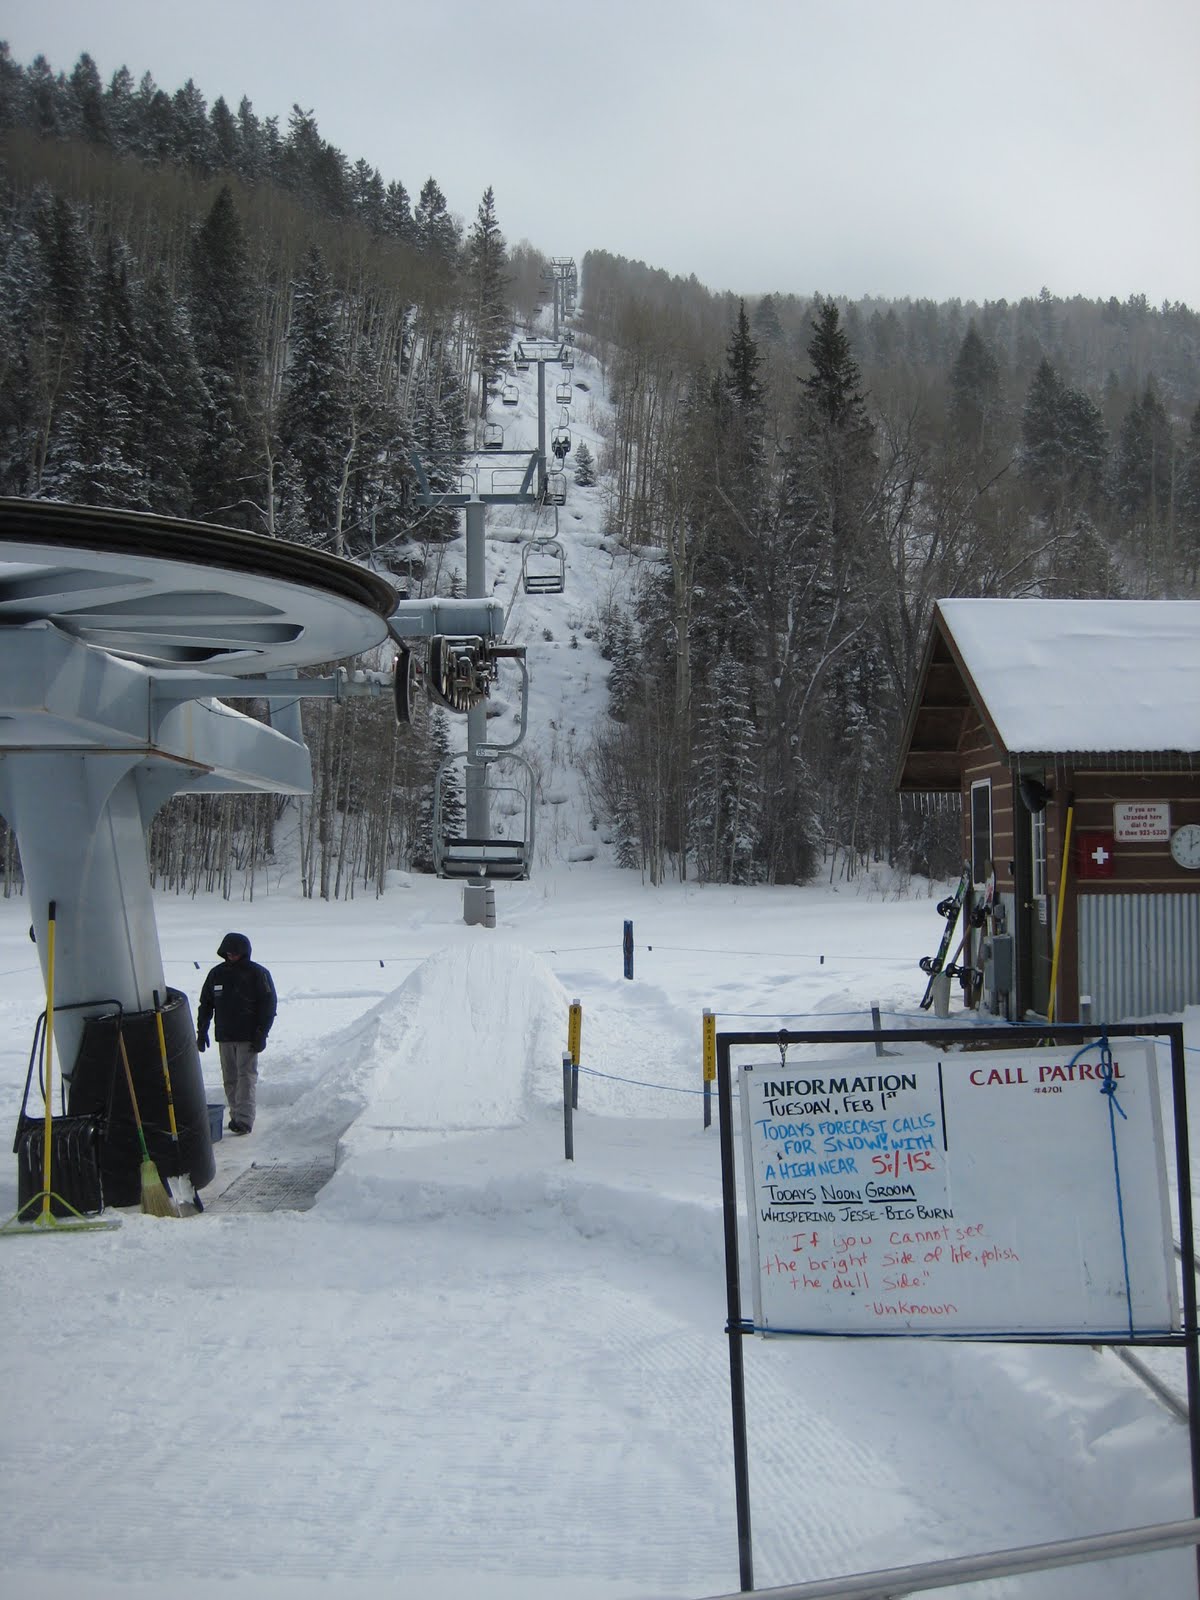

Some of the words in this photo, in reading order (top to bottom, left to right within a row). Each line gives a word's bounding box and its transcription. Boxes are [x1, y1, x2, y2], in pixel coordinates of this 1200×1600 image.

[969, 1068, 1028, 1086] CALL
[1038, 1062, 1125, 1083] PATROL
[764, 1074, 917, 1097] INFORMATION
[1033, 1086, 1063, 1094] #4701
[843, 1095, 874, 1113] FEB
[754, 1119, 815, 1140] TODAYS
[818, 1119, 887, 1136] FORECAST
[892, 1114, 936, 1133] CALLS
[784, 1139, 817, 1155] FOR
[891, 1134, 936, 1150] WITH
[765, 1164, 776, 1181] A
[780, 1161, 816, 1179] HIGH
[818, 1157, 859, 1177] NEAR
[761, 1184, 817, 1201] TODAYS
[820, 1184, 861, 1200] NOON
[865, 1181, 916, 1197] GROOM
[761, 1209, 836, 1223] WHISPERING
[916, 1205, 954, 1220] BURN
[833, 1235, 872, 1253] you
[956, 1223, 985, 1241] see
[763, 1255, 797, 1275] the
[808, 1250, 868, 1275] bright
[882, 1250, 915, 1267] side
[924, 1246, 943, 1262] of
[981, 1245, 1019, 1267] polish
[790, 1272, 822, 1290] the
[832, 1272, 869, 1290] dull
